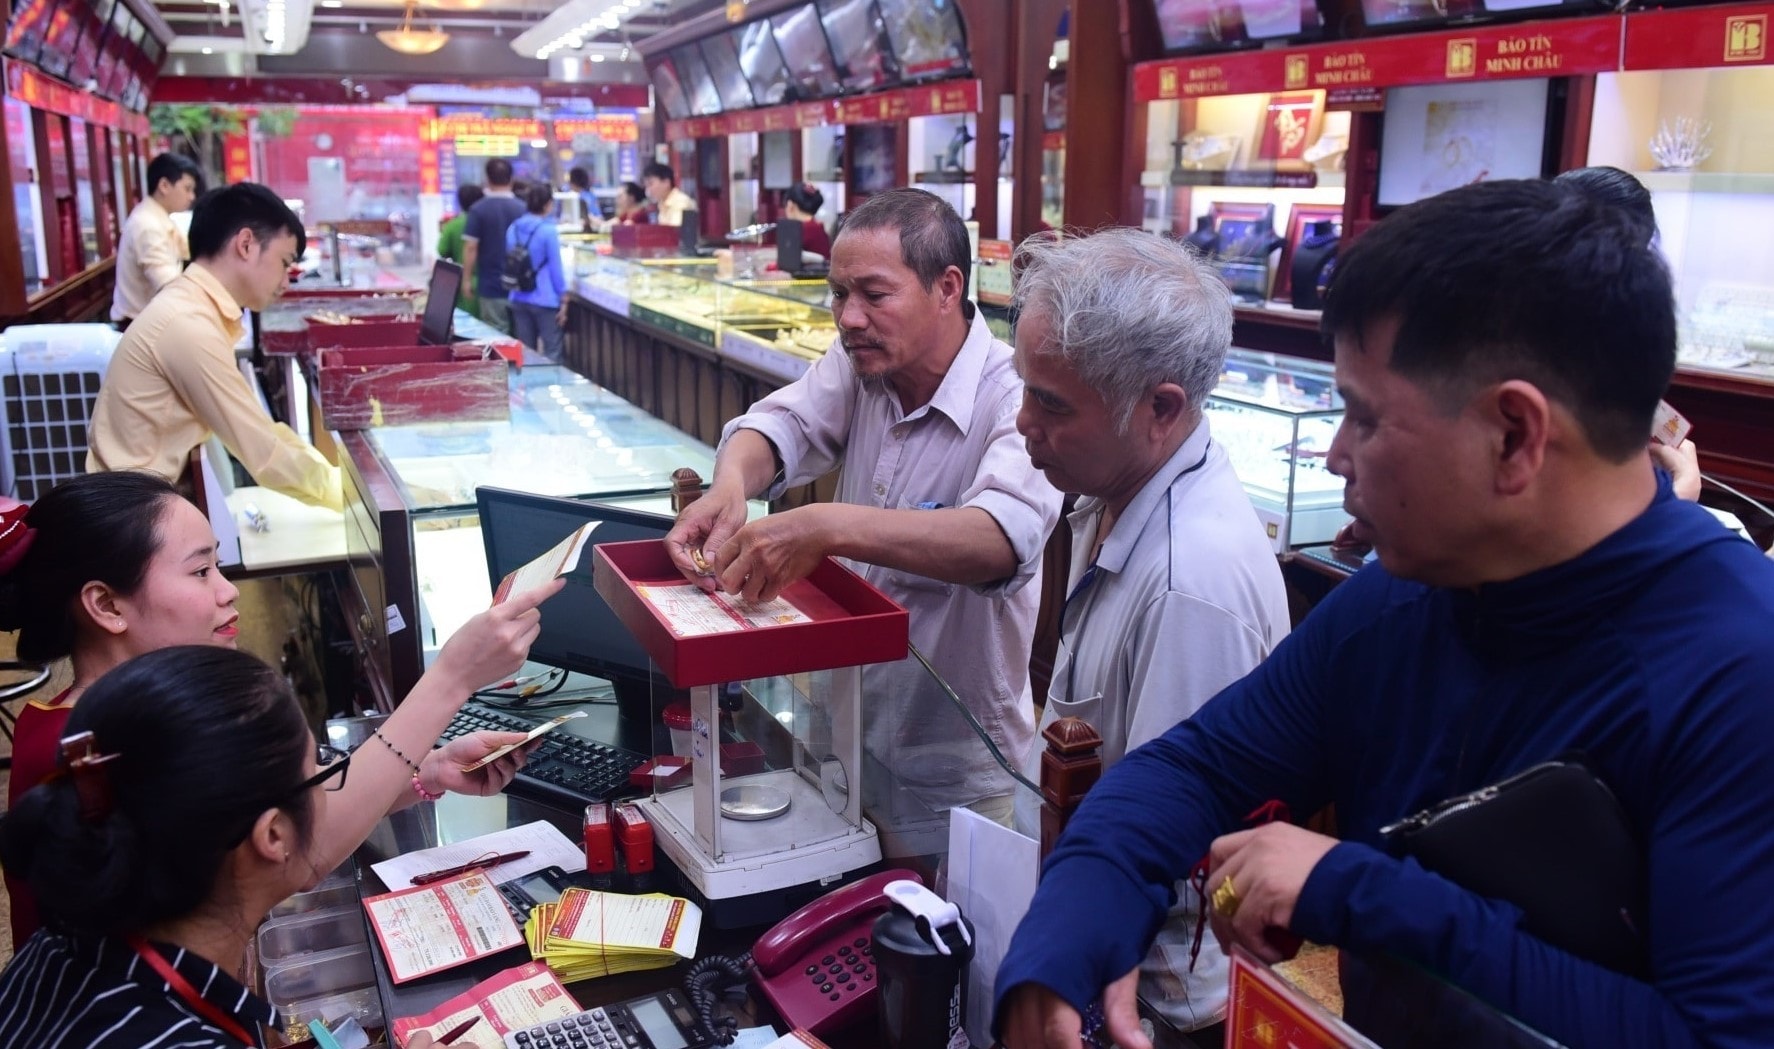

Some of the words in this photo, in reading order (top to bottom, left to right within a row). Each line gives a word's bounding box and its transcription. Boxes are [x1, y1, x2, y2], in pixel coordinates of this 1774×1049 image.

[1498, 36, 1527, 54] BẢO
[1529, 34, 1552, 51] TÍN
[1486, 57, 1521, 73] MINH
